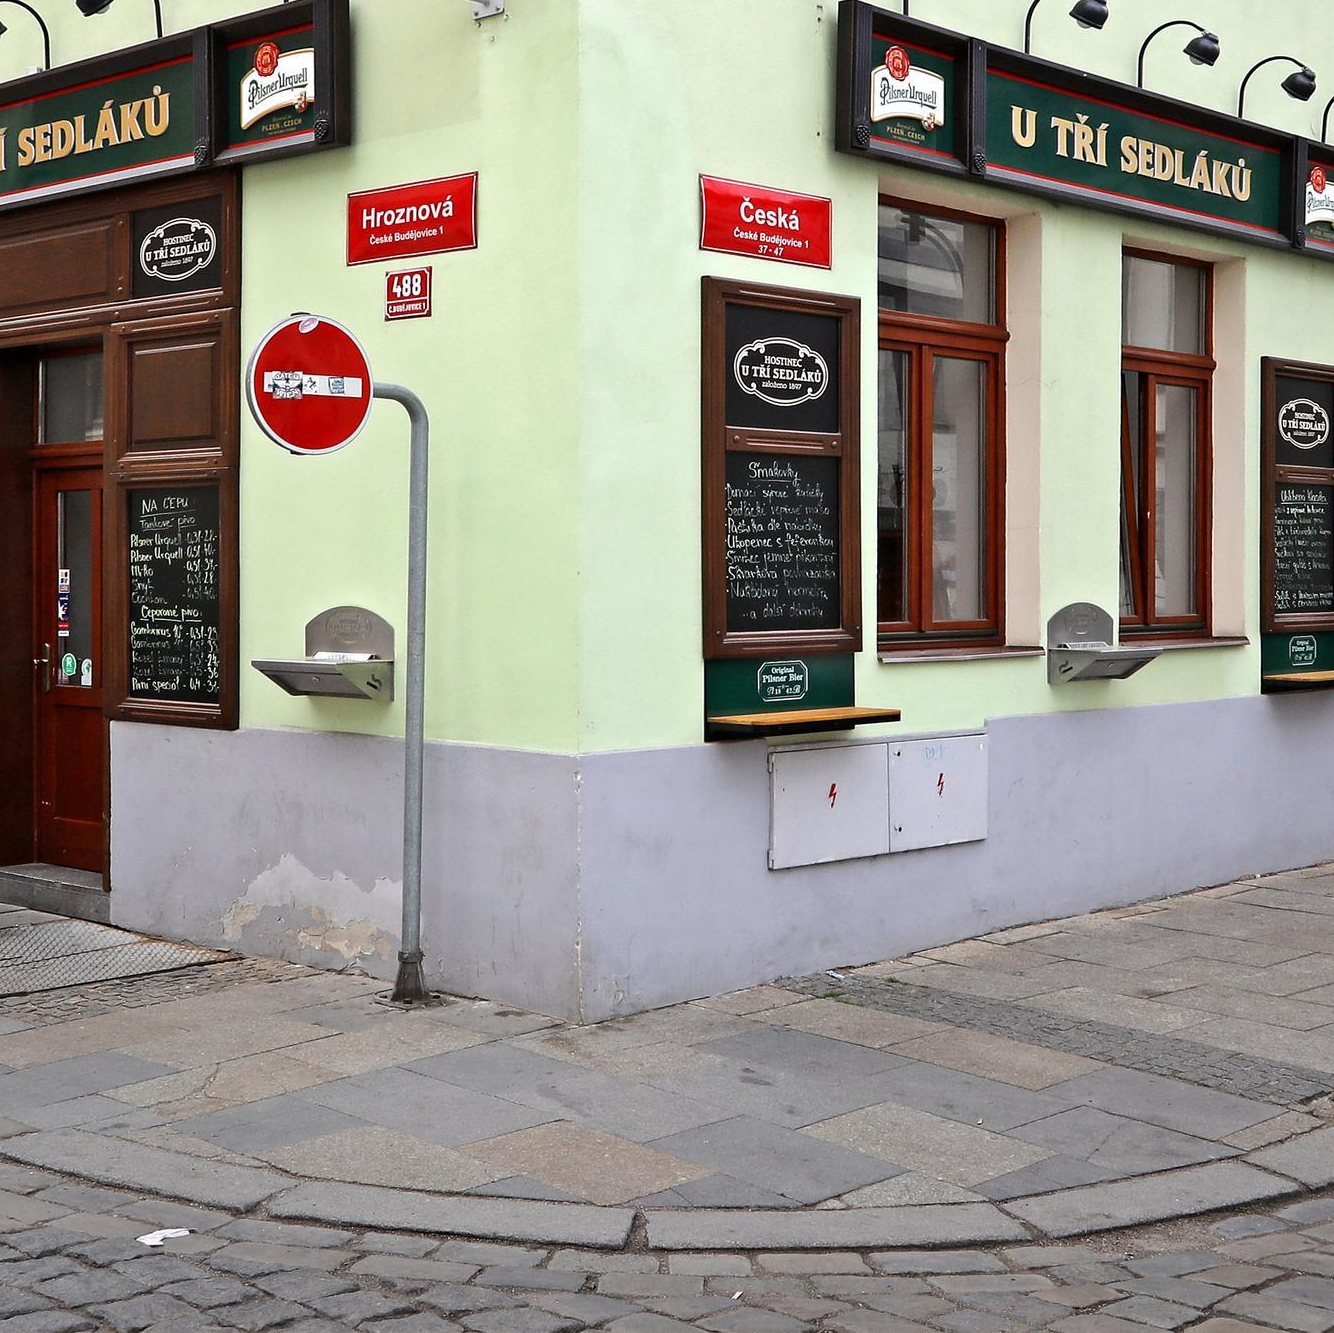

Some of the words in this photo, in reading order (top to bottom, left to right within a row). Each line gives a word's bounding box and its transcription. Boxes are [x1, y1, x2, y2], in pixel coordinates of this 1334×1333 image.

[248, 79, 279, 110] Pilsner
[278, 67, 308, 92] Urquell
[880, 77, 910, 106] Pilsner
[908, 83, 937, 107] Urquell
[17, 84, 171, 167] SEDLÁKŮ
[1010, 105, 1038, 149] U
[1051, 113, 1110, 168] TŘÍ
[1120, 135, 1253, 202] SEDLÁKŮ
[362, 195, 453, 229] Hroznová
[739, 196, 800, 231] Česká
[369, 232, 393, 245] České
[394, 226, 438, 243] Budějovice
[439, 225, 444, 235] 1
[733, 227, 758, 241] České
[759, 233, 802, 248] Budějovice
[804, 240, 809, 248] 1
[146, 251, 152, 261] U
[153, 247, 169, 260] TŘÍ
[169, 239, 210, 257] SEDLÁKŮ
[758, 245, 768, 254] 37
[773, 247, 784, 256] 47
[392, 273, 422, 298] 488
[764, 355, 802, 368] HOSTINEC
[741, 365, 750, 376] U
[752, 364, 771, 378] TŘÍ
[772, 368, 822, 383] SEDLÁKŮ
[142, 499, 158, 514] NA
[788, 673, 804, 681] Bier
